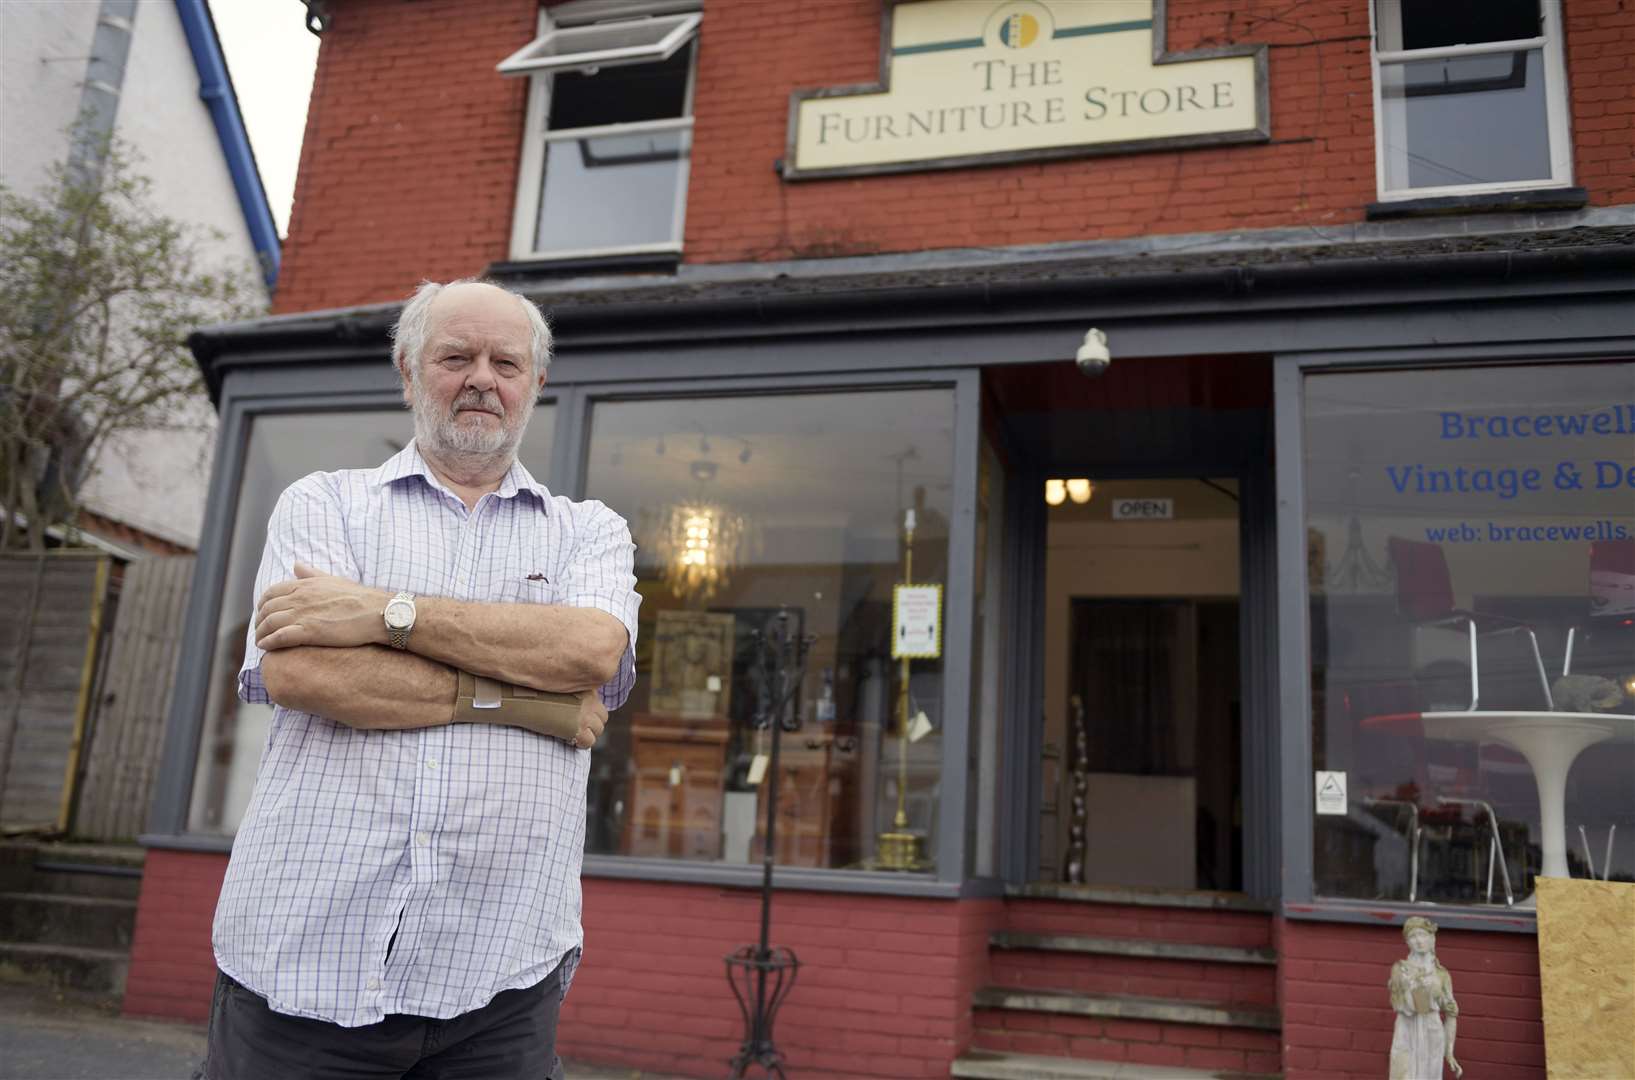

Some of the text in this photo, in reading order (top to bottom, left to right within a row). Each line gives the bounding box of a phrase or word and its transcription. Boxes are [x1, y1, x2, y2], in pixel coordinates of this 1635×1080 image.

[973, 59, 1062, 92] THE
[817, 82, 1234, 145] FURNITURE STORE
[1386, 464, 1541, 499] Vintage
[1553, 462, 1582, 490] &
[1120, 502, 1167, 515] OPEN
[1425, 523, 1481, 542] web:
